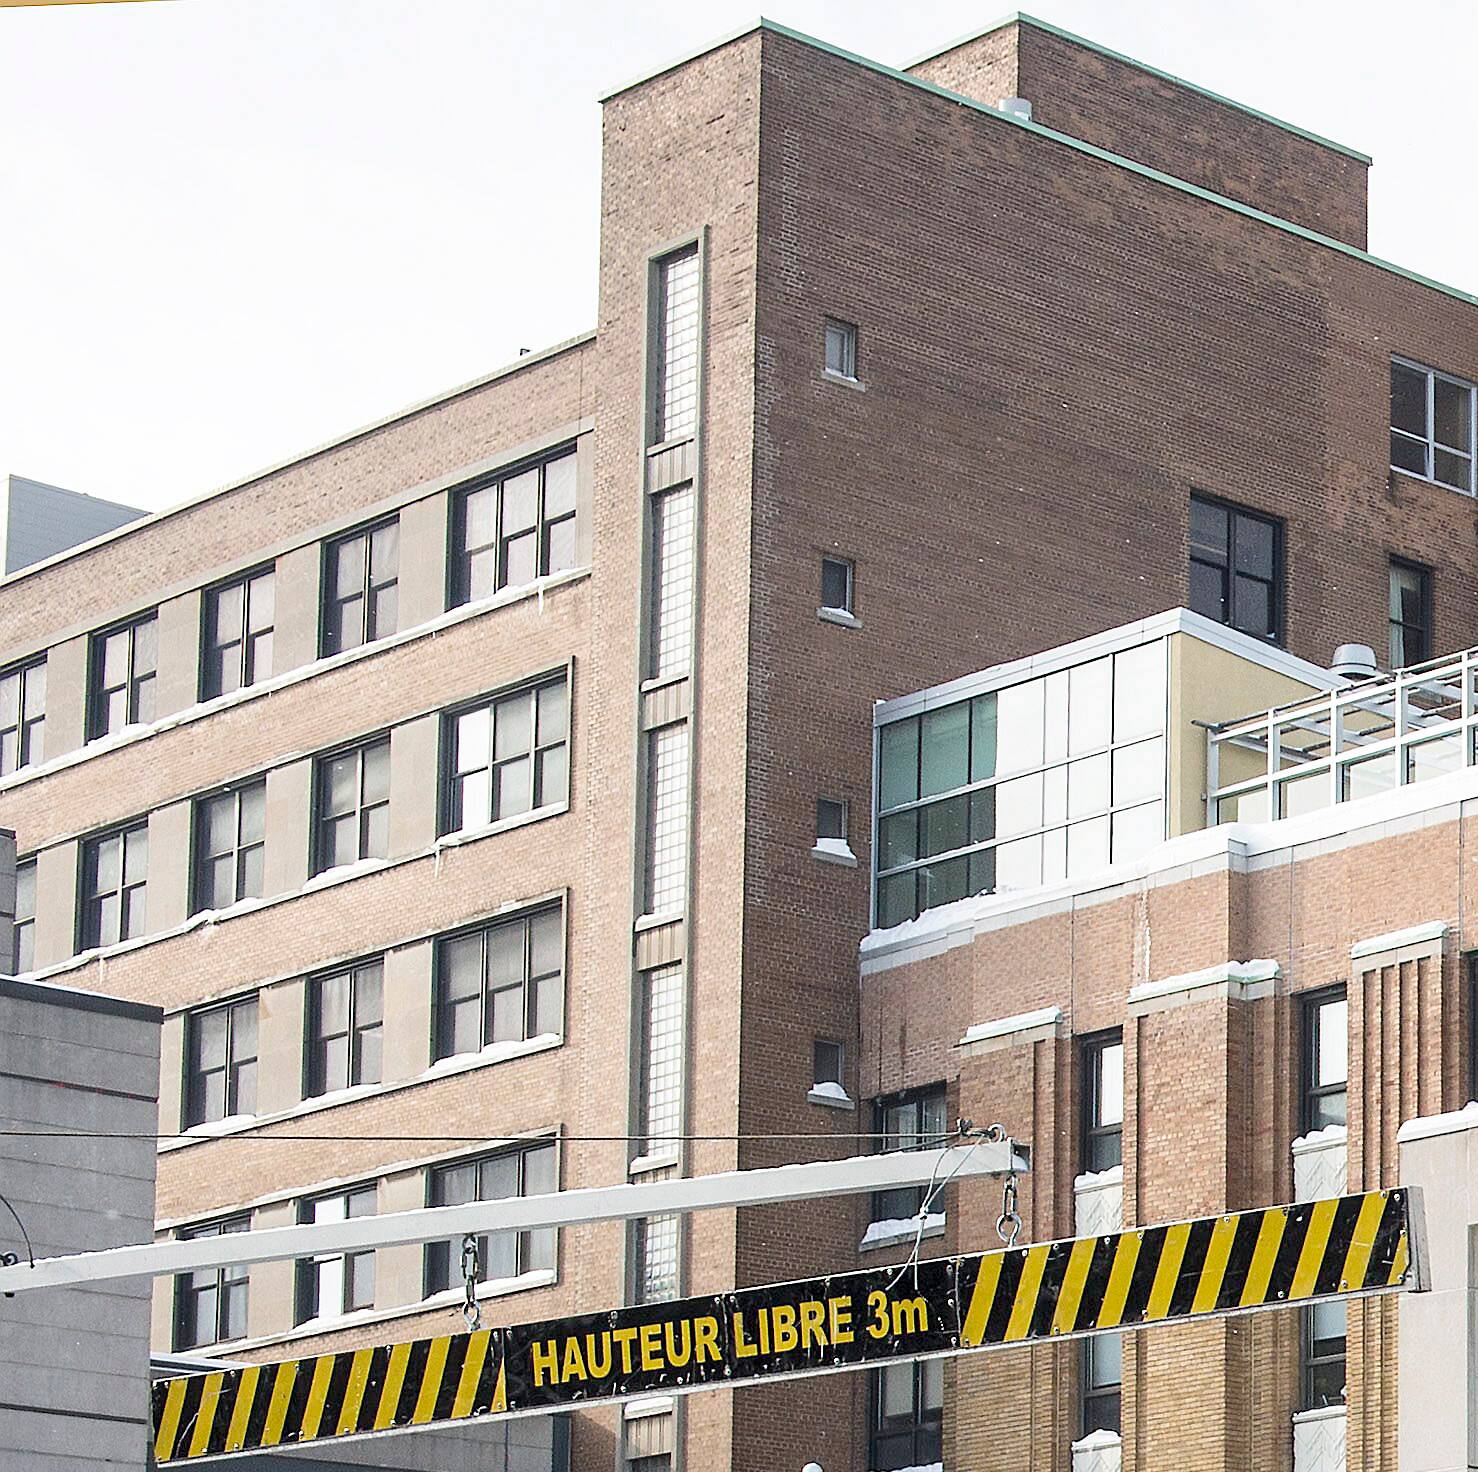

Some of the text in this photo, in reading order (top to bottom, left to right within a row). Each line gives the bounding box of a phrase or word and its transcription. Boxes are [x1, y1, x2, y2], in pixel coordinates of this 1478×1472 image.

[531, 1289, 929, 1388] HAUTEUR LIBRE 3m
